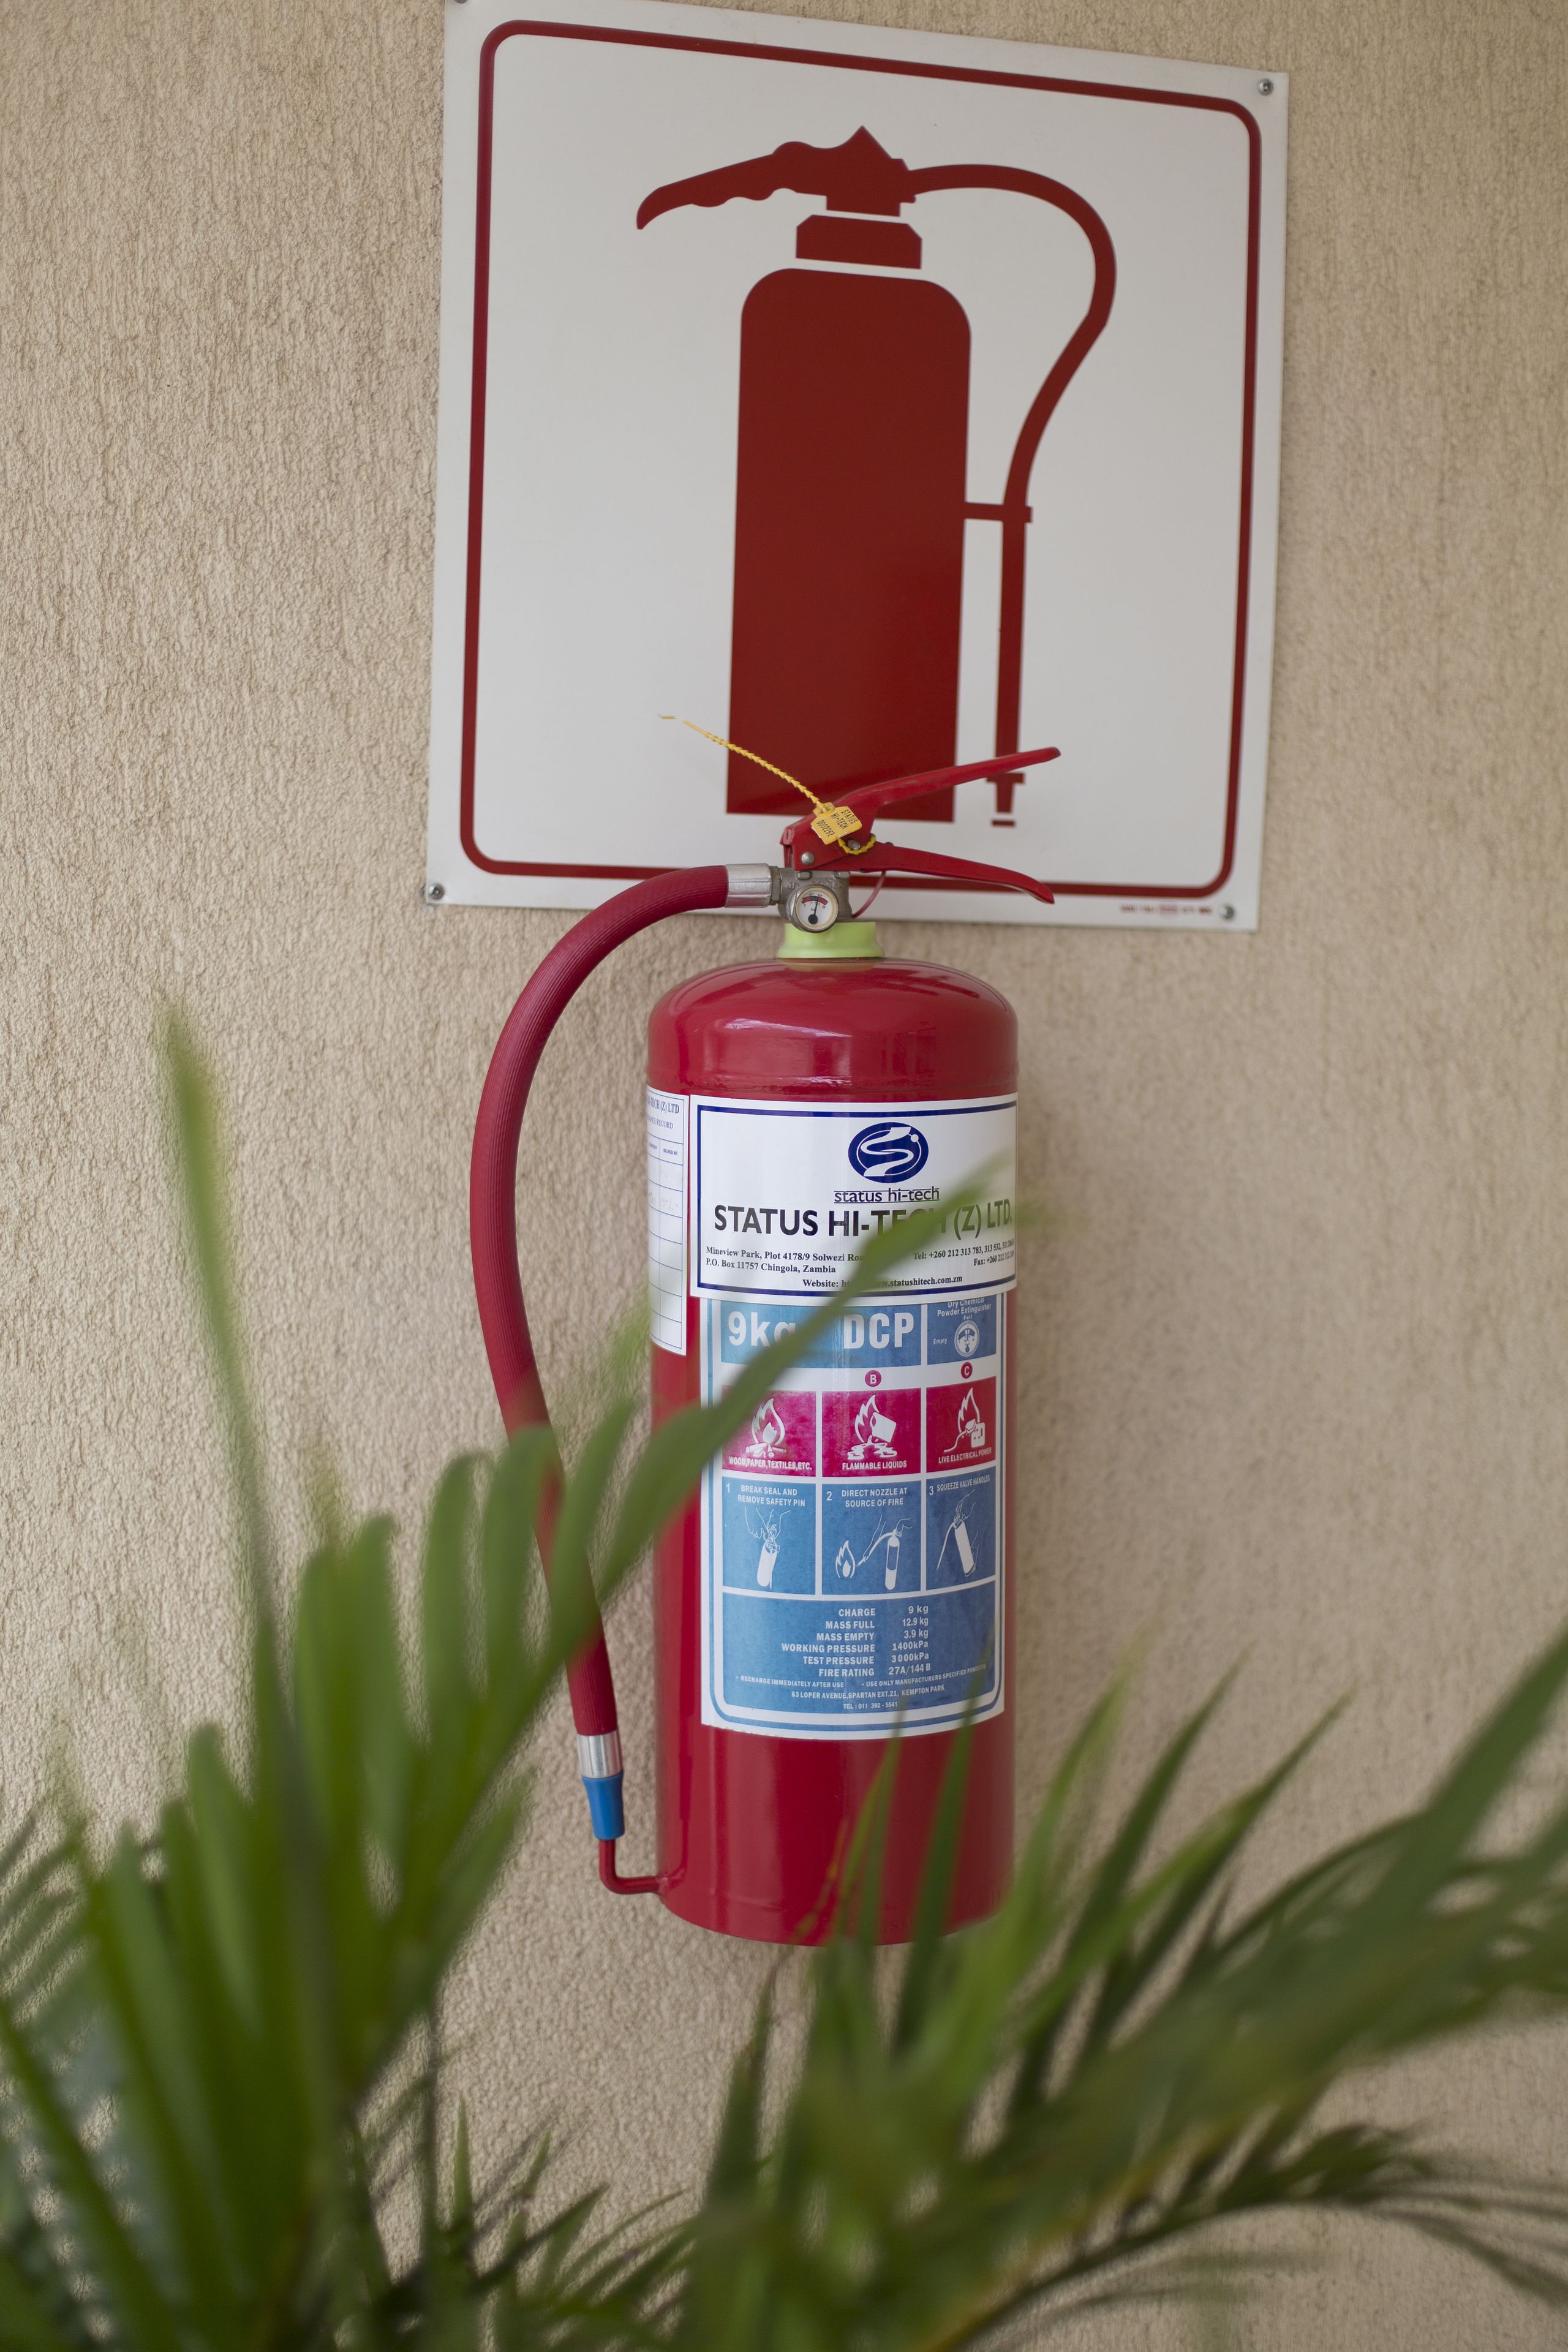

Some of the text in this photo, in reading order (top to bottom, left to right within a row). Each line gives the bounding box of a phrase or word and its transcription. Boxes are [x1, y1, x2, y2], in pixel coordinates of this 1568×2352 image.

[831, 813, 849, 829] HI-TECH
[841, 809, 858, 824] STATUS
[668, 1102, 679, 1114] LTD
[657, 1118, 673, 1129] RECORD
[834, 1186, 940, 1202] status hi-tech
[714, 1199, 1012, 1240] STATUS HI-TEH (Z) LTD.
[706, 1246, 739, 1256] Mineview
[741, 1250, 762, 1260] Park,
[764, 1251, 780, 1260] Plot
[914, 1251, 927, 1260] Tel:
[929, 1250, 946, 1259] +260
[948, 1249, 959, 1257] 212
[972, 1246, 983, 1254] 783,
[984, 1244, 993, 1253] 313
[706, 1257, 719, 1266] P.O.
[737, 1261, 758, 1270] 11757
[761, 1264, 800, 1273] Chingola,
[986, 1255, 997, 1264] +260
[802, 1279, 839, 1287] Website:
[960, 1297, 985, 1306] Chemical
[937, 1303, 992, 1317] Powder Extinguisher
[843, 1312, 914, 1349] DCP
[951, 1450, 978, 1461] ELECTRICAL
[978, 1447, 992, 1456] POWER
[842, 1460, 907, 1470] FLAMMABLE LIQUIDS
[726, 1483, 730, 1493] 1
[741, 1485, 763, 1493] BREAK
[937, 1474, 990, 1492] SQUEEZE VALVE HANDLES
[826, 1491, 832, 1501] 2
[929, 1485, 934, 1496] 3
[737, 1494, 765, 1504] REMOVE
[766, 1497, 791, 1506] SAFETY
[838, 1608, 876, 1617] CHARGE
[917, 1605, 929, 1615] kg
[825, 1616, 929, 1629] MASS FULL 12.9 kg
[816, 1629, 929, 1641] MASS EMPTY 3.9 kg
[782, 1640, 929, 1653] WORKING PRESSURE 1400kPa
[803, 1656, 824, 1665] TEST
[826, 1656, 875, 1665] PRESSURE
[819, 1668, 839, 1677] FIRE
[842, 1668, 875, 1677] RATING
[895, 1674, 942, 1685] MANUFACTURERS
[942, 1669, 967, 1679] SPECIFIED
[741, 1675, 771, 1684] RECHARGE
[772, 1678, 811, 1687] IMMEDIATELY
[901, 1686, 930, 1696] KEMPTON
